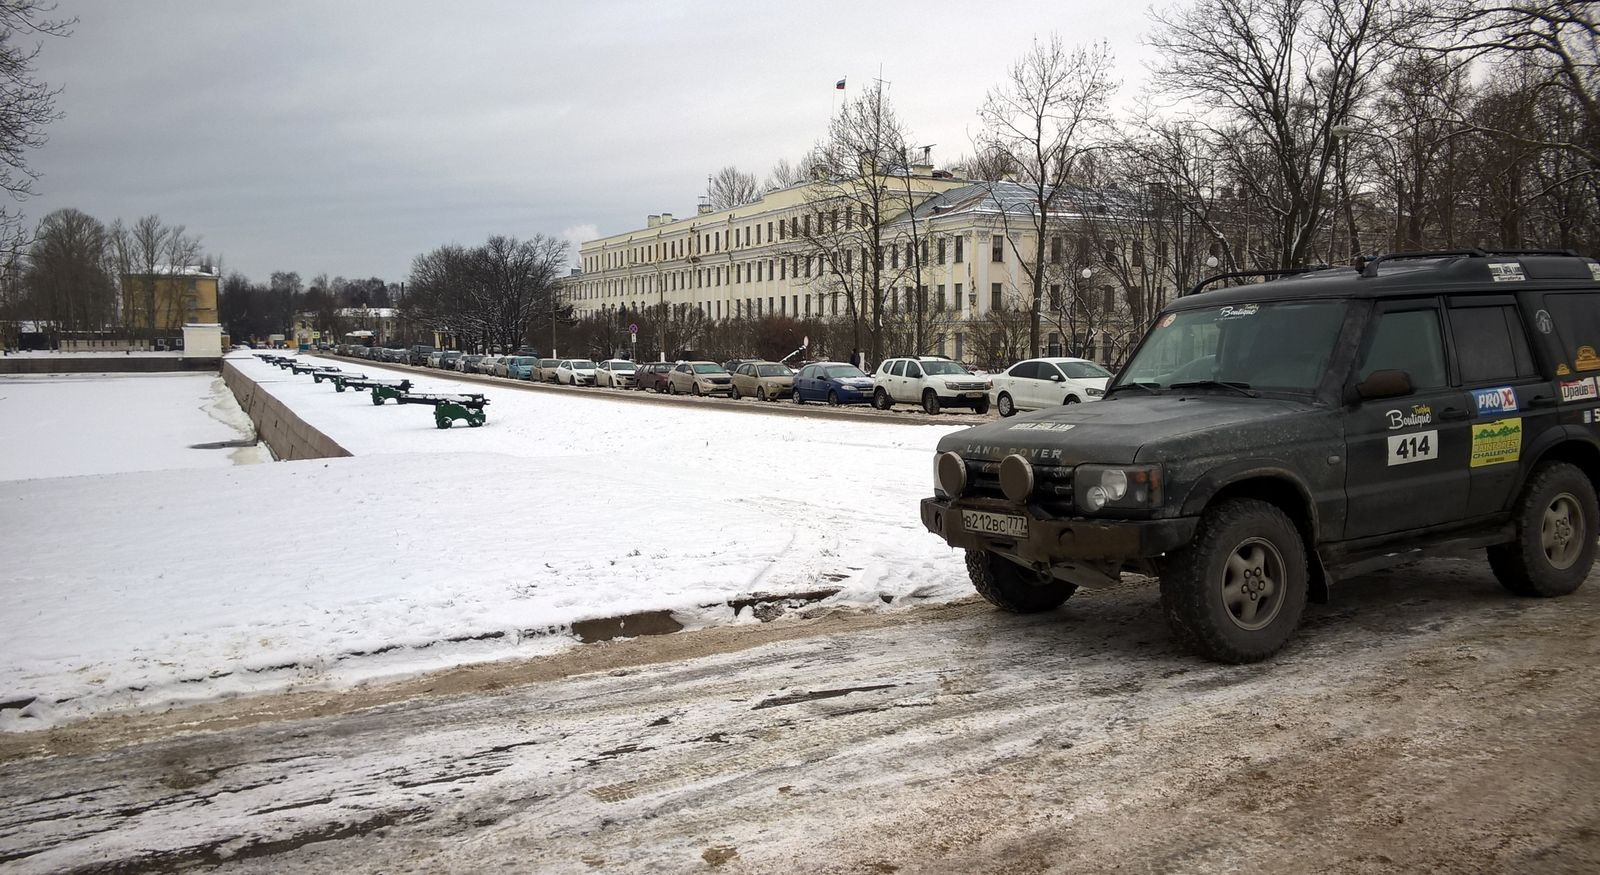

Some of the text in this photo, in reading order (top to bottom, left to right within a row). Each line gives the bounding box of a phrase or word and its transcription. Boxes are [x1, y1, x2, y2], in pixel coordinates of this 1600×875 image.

[1478, 392, 1500, 409] PRO
[1385, 409, 1432, 429] Boutique
[966, 444, 1063, 459] LAND ROVER
[1396, 435, 1431, 459] 414
[1472, 448, 1518, 460] CHALLENGE
[965, 513, 1025, 532] В212ВС 777
